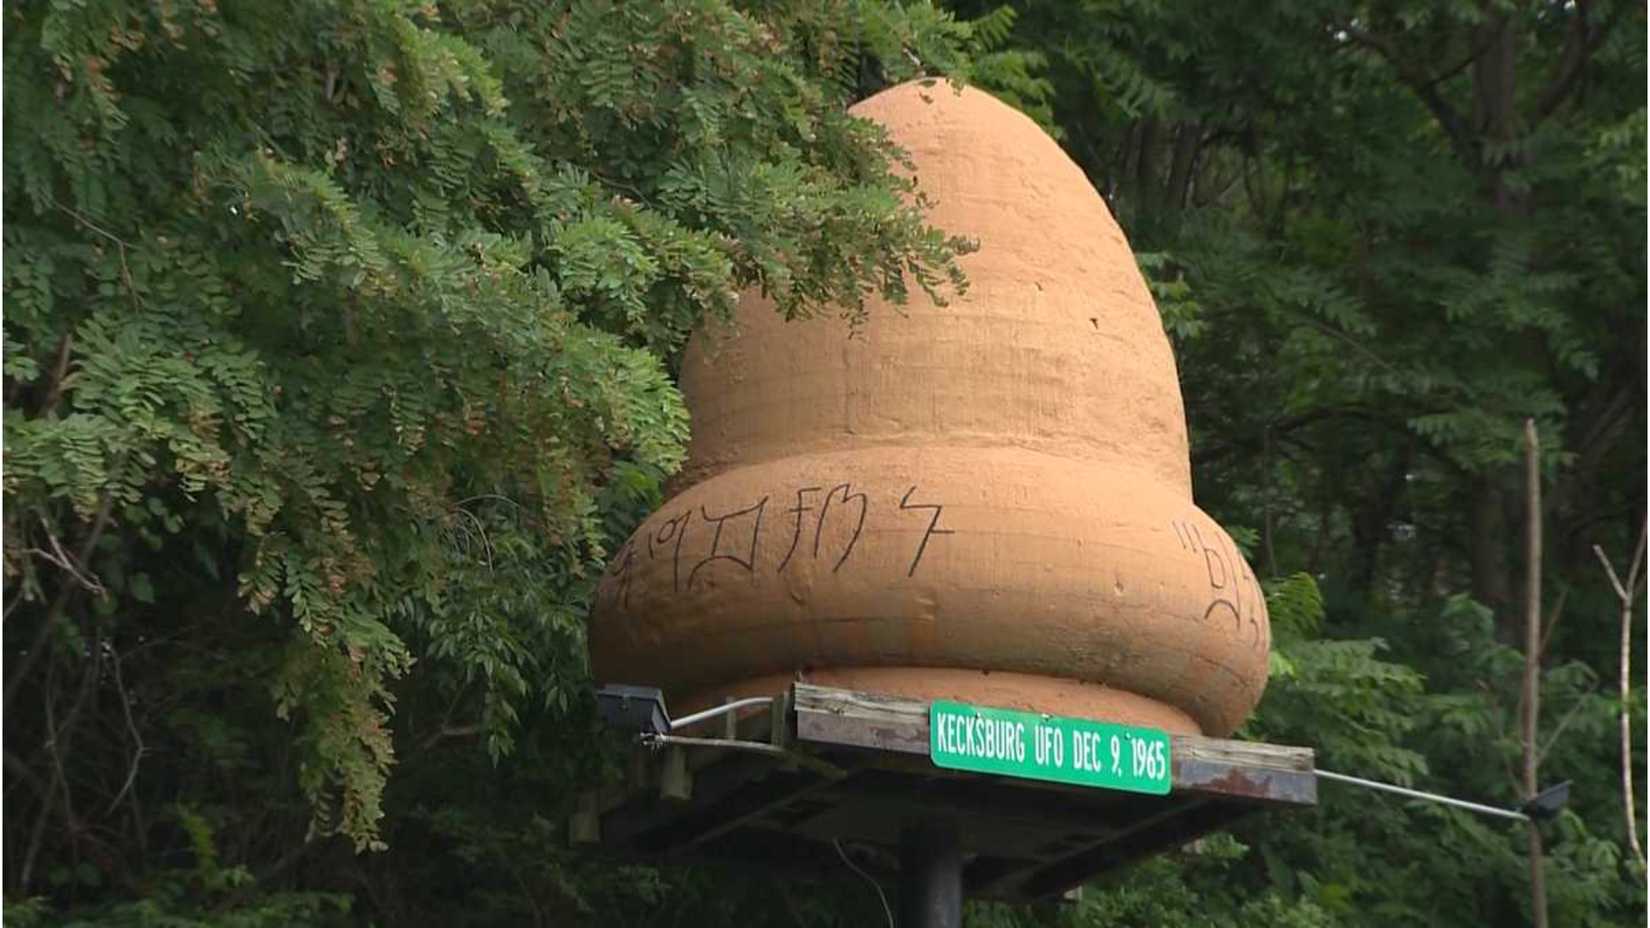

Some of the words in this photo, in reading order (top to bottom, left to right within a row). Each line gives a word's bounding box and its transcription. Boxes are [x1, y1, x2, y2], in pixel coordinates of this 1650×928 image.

[936, 711, 1025, 763] KECKSBURG
[1035, 725, 1064, 768] UFO
[1072, 730, 1101, 772] DEC
[1110, 735, 1122, 777] 9,
[1130, 738, 1166, 780] 1965
